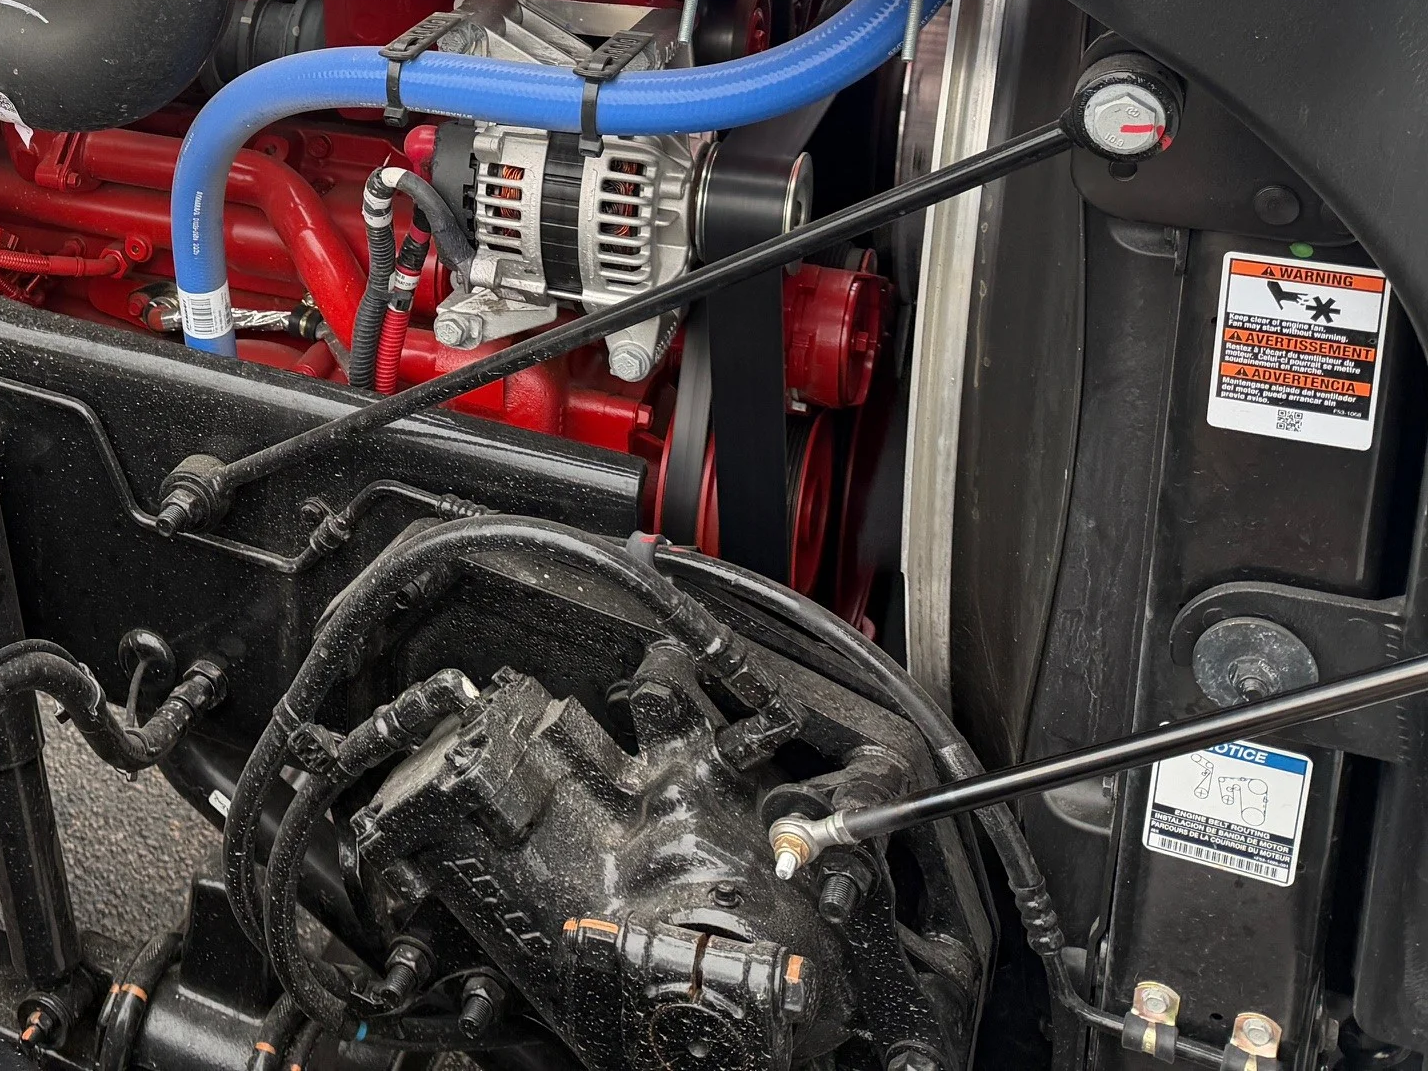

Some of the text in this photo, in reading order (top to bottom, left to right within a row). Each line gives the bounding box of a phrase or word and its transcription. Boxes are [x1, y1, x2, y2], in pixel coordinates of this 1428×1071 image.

[1278, 266, 1353, 287] WARNING
[1228, 319, 1348, 343] Fan may start without warning.
[1229, 312, 1248, 322] Keep
[1250, 315, 1270, 324] clear
[1281, 320, 1308, 330] engine
[1310, 323, 1326, 332] fan.
[1245, 332, 1371, 359] AVERTISSEMENT
[1251, 368, 1356, 393] ADVERTENCIA
[1292, 364, 1323, 375] marche.
[1220, 390, 1269, 403] previo aviso.
[1154, 813, 1204, 832] INSTALACION
[1205, 825, 1217, 835] DE
[1217, 828, 1245, 842] BANDA
[1246, 835, 1258, 844] DE
[1258, 839, 1289, 852] MOTOR
[1174, 809, 1270, 838] ENGINE BELT ROUTING
[1151, 820, 1187, 836] PARCOURS
[1199, 832, 1209, 840] LA
[1209, 834, 1247, 850] COURROIE
[1247, 844, 1258, 853] DU
[1259, 846, 1290, 861] MOTEUR
